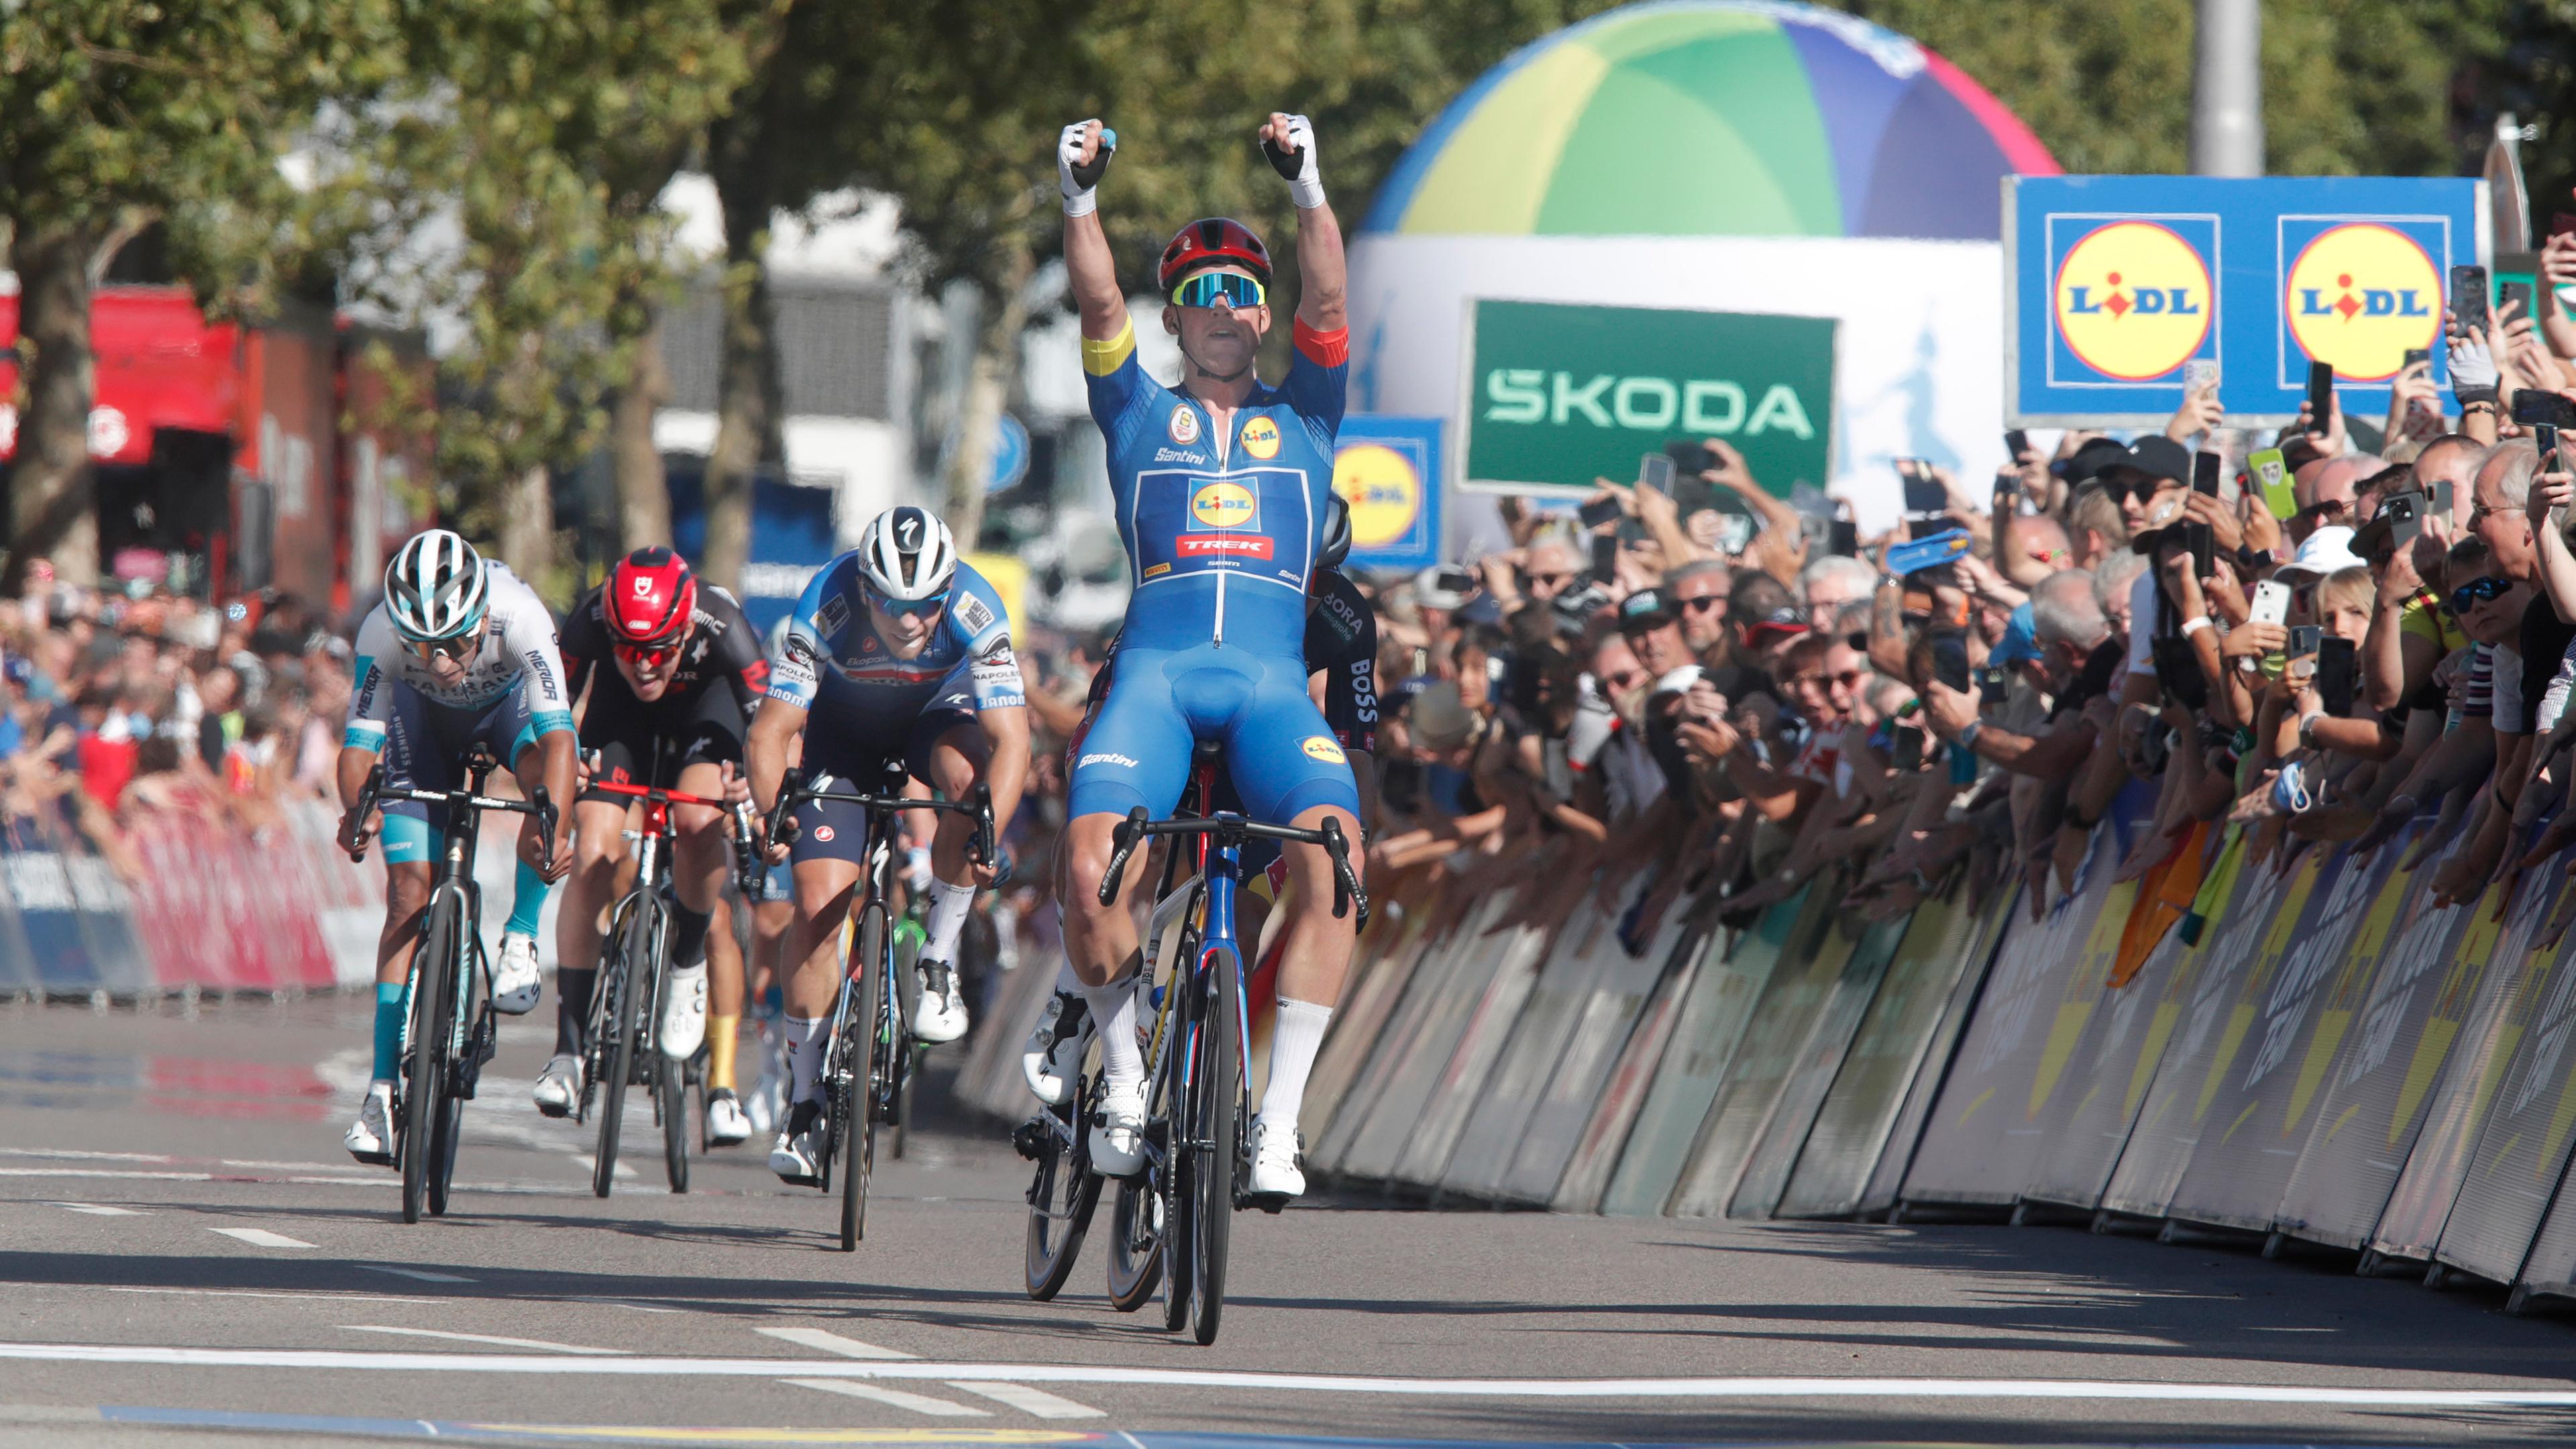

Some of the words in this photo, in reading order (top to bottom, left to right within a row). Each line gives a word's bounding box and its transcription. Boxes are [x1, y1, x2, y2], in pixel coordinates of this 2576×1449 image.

[2068, 271, 2199, 321] LIDL
[2299, 273, 2430, 323] LIDL
[1243, 430, 1277, 443] LIDL
[1154, 447, 1206, 465] Santini
[1196, 496, 1250, 511] LIDL
[1184, 541, 1263, 551] TREK
[1278, 570, 1301, 584] Santini
[692, 608, 727, 635] BMC
[965, 608, 984, 630] JOGGER
[971, 600, 993, 623] SAFETY
[1319, 603, 1351, 641] hansgrohe
[1324, 592, 1363, 635] BORA
[846, 655, 890, 665] Ekopak
[525, 649, 558, 702] MERIDA
[356, 664, 382, 718] MERIDA
[1350, 659, 1378, 723] BOSS
[1078, 753, 1139, 769] Santini
[1307, 744, 1342, 757] LIDL
